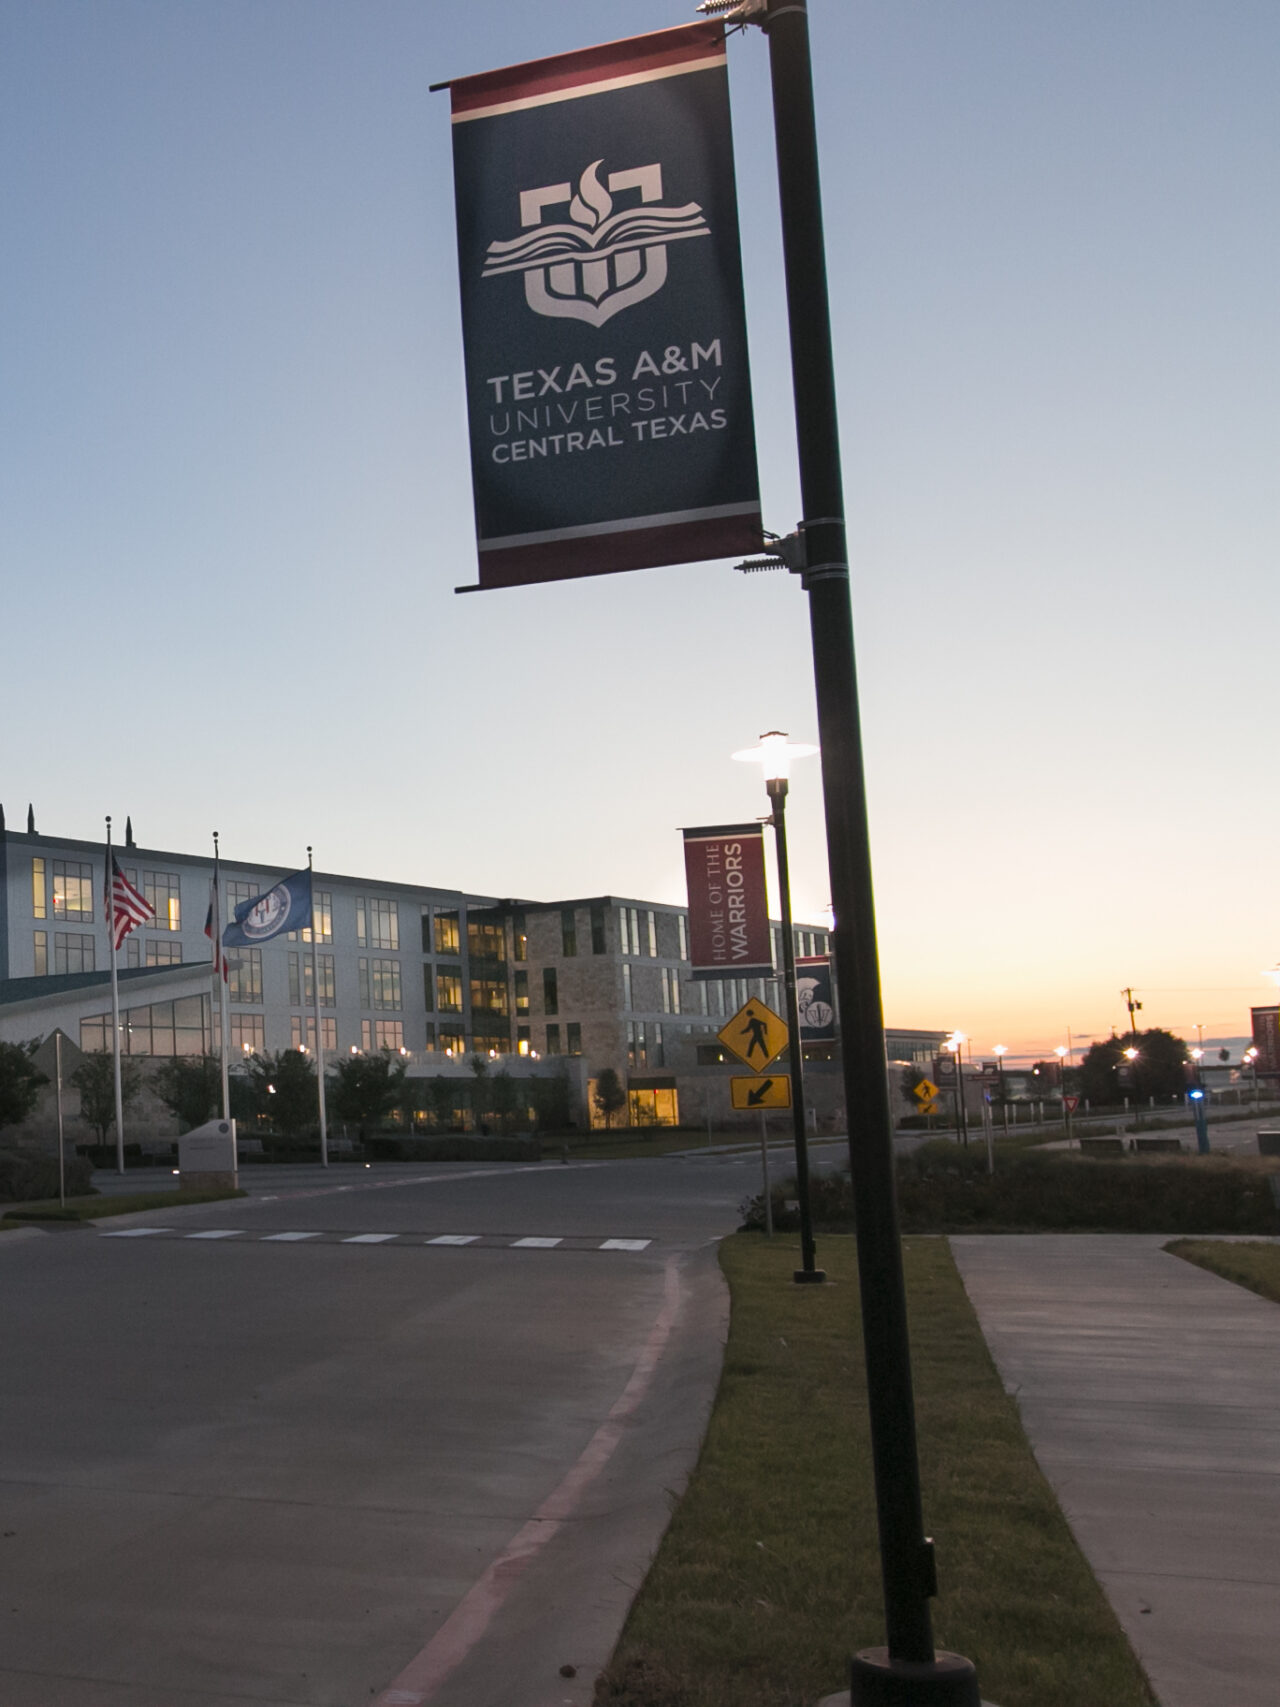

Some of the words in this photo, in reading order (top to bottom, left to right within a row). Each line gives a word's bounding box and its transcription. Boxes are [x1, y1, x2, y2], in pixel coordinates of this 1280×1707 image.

[487, 358, 617, 404] TEXAS
[632, 339, 723, 381] A&M
[490, 377, 722, 436] UNIVERSITY
[492, 427, 624, 464] CENTRAL
[631, 409, 728, 441] TEXAS
[706, 844, 720, 877] THE
[708, 883, 722, 904] OF
[724, 843, 749, 960] WARRIORS
[711, 910, 726, 961] HOME
